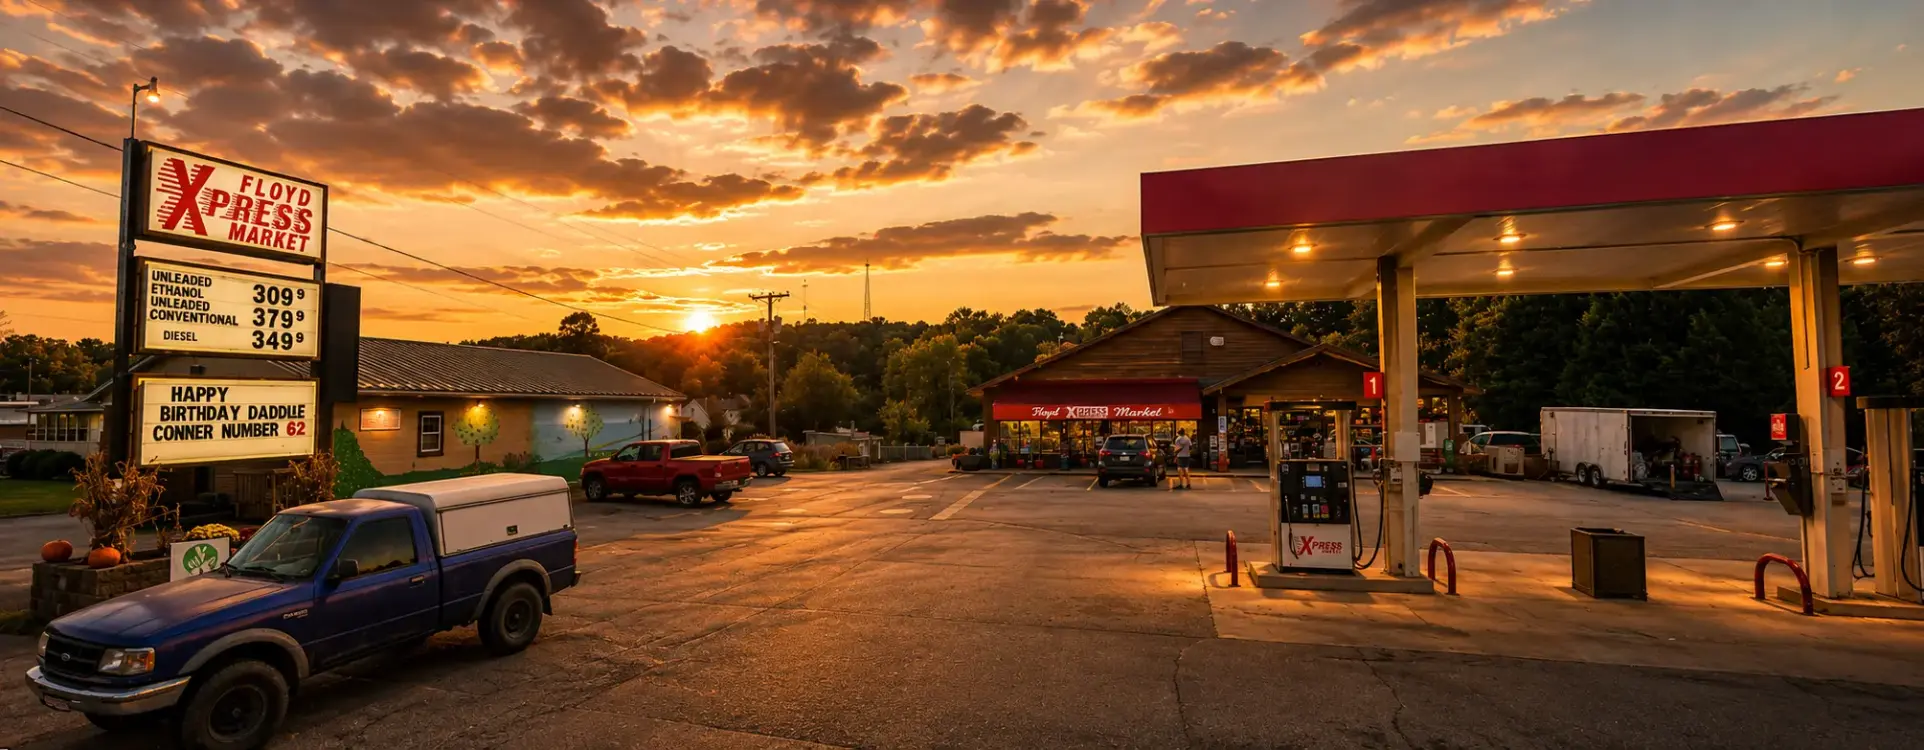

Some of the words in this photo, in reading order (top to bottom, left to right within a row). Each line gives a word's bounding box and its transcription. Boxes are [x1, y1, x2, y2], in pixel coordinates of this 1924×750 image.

[158, 157, 314, 237] XPRESS
[239, 174, 312, 207] FLOYD
[227, 222, 311, 253] MARKET
[152, 270, 213, 288] UNLEADED
[151, 283, 205, 299] ETHANOL
[150, 295, 211, 312] UNLEADED
[149, 308, 239, 327] CONVENTIONAL
[163, 330, 198, 342] DIESEL
[1369, 376, 1377, 395] 1
[1833, 371, 1846, 390] 2
[171, 386, 229, 403] HAPPY
[160, 405, 241, 422] BIRTHDAY
[1031, 406, 1061, 419] Floyd
[1113, 406, 1162, 417] Market
[153, 424, 214, 441] CONNER
[221, 422, 279, 439] NUMBER
[286, 421, 306, 437] 62
[1297, 535, 1343, 556] XPRESS
